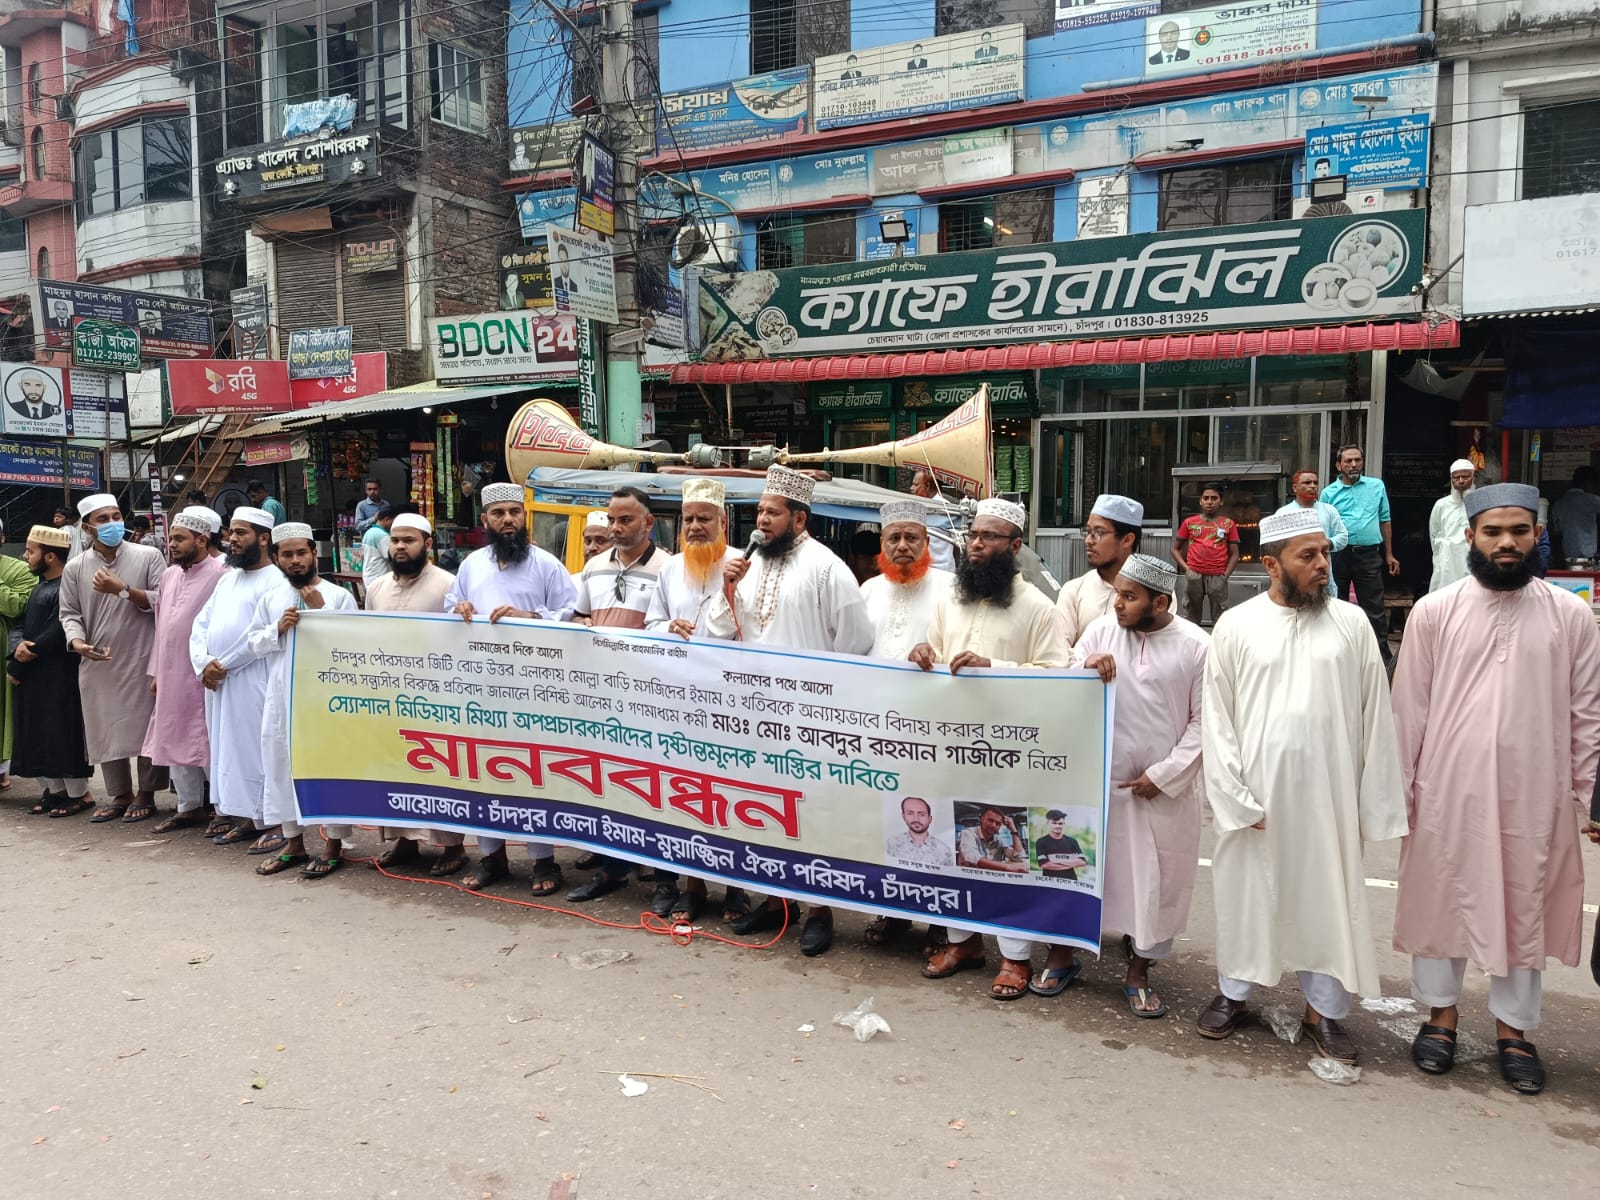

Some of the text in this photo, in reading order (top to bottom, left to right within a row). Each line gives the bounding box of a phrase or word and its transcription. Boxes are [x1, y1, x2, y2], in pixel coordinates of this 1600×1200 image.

[1205, 42, 1310, 65] 01818-849561
[257, 147, 299, 168] খালেদ
[304, 134, 370, 160] মোশাররফ
[1309, 134, 1329, 156] মোঃ
[346, 239, 396, 257] TO-LET
[800, 228, 1303, 333] ক্যাফে হীরাঝিল
[867, 333, 904, 346] চেয়ারম্যান
[925, 331, 951, 344] (জেলা
[951, 328, 991, 341] প্রশাসকের
[993, 322, 1035, 337] কার্যালয়ের
[1114, 311, 1209, 330] 01830-813925
[77, 327, 104, 348] কাজী
[106, 331, 138, 353] অফিস
[437, 317, 577, 359] BDCN 24
[77, 347, 138, 362] 01712-239902
[226, 365, 257, 392] রবি
[819, 390, 883, 408] ক্যাফে হীরাঝিল
[468, 641, 563, 660] নামাজের দিকে আসো
[331, 647, 1040, 744] চাঁদপুর পৌরসভার জিটি রোড উত্তর এলাকায় মোল্লা বাড়ি মসজিদের ইমাম ও খতিবকে অন্যায়ভাবে বিদায় করার প্রসঙ্গে
[722, 669, 833, 697] কল্যাণের পথে আসো
[317, 667, 1068, 772] কতিপয় সন্ত্রাসীর বিরুদ্ধে প্রতিবাদ জানালে বিশিষ্ট আলেম ও গণমাধ্যম কর্মী মাওঃ মোঃ আবদুর রহমান গাজীকে নিয়ে
[394, 694, 462, 725] মিডিয়ায়
[465, 701, 508, 729] মিথ্যা
[512, 711, 653, 750] অপপ্রচারকারীদের
[656, 731, 757, 770] দৃষ্টান্তমূলক
[762, 748, 822, 781] শাস্তির
[827, 758, 900, 792] দাবিতে
[399, 727, 804, 840] মানববন্ধন
[387, 791, 470, 820] আয়োজনে
[487, 799, 548, 835] চাঁদপুর
[552, 808, 598, 838] জেলা
[600, 813, 735, 872] ইমাম-মুয়াজ্জিন
[740, 844, 787, 881] ঐক্য
[792, 858, 876, 899] পরিষদ,
